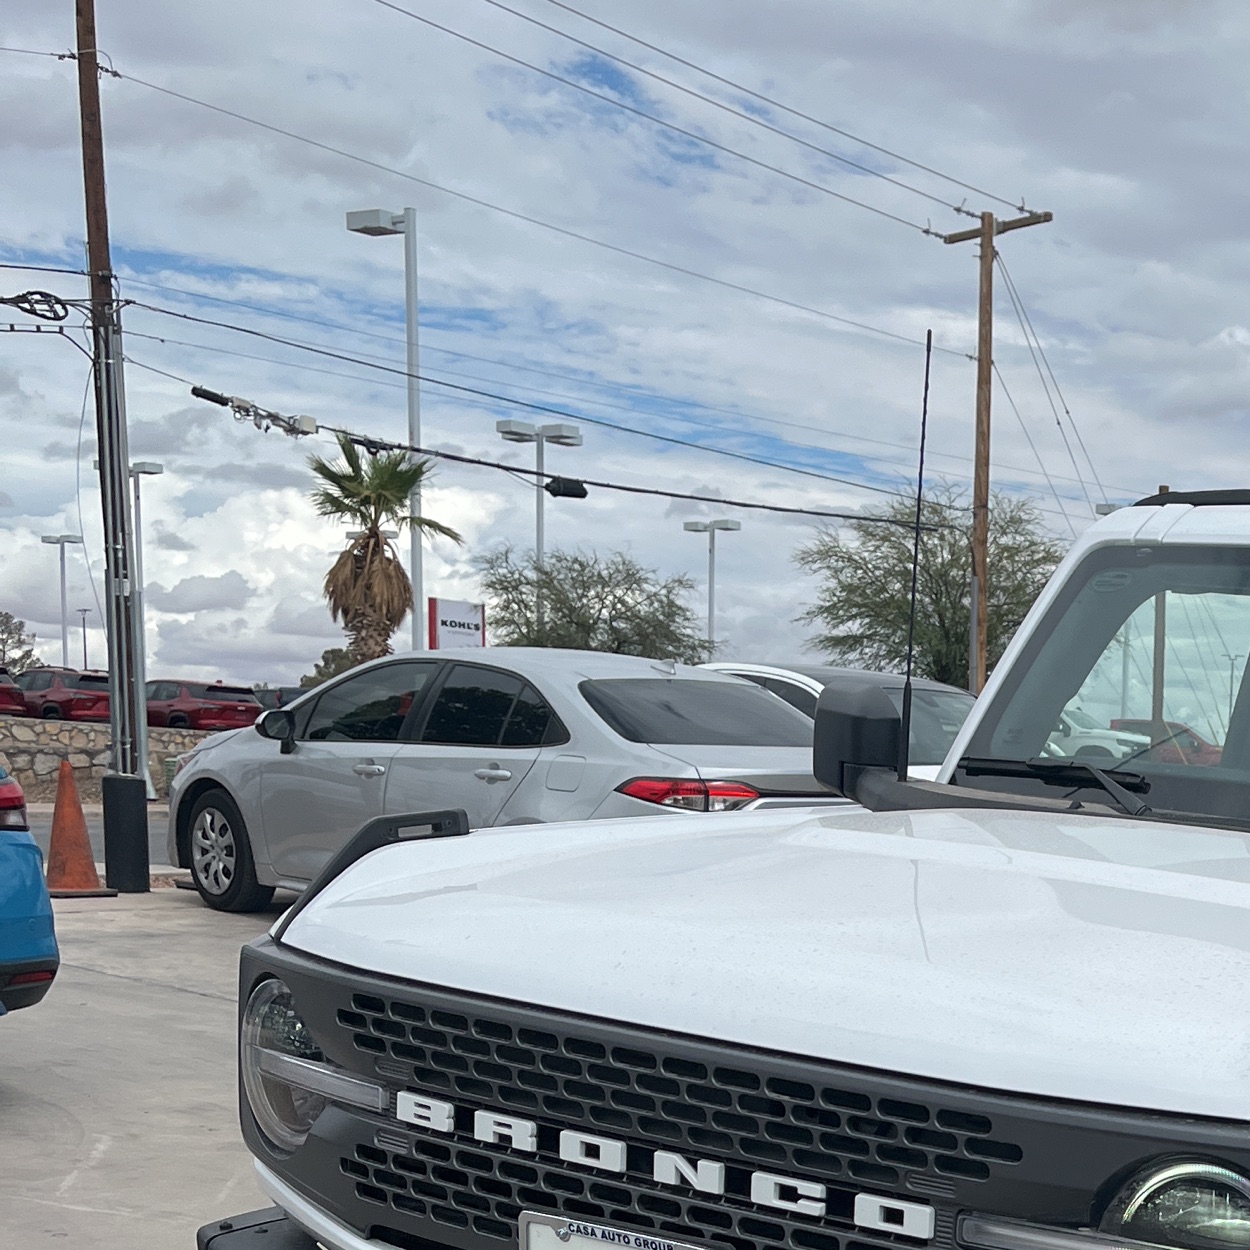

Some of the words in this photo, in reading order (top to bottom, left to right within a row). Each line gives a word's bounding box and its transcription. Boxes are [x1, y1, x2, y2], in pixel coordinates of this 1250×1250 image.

[440, 619, 480, 632] KOHL'S
[396, 1090, 936, 1240] BRONCO
[568, 1222, 598, 1238] CASA
[601, 1232, 631, 1245] AUTO
